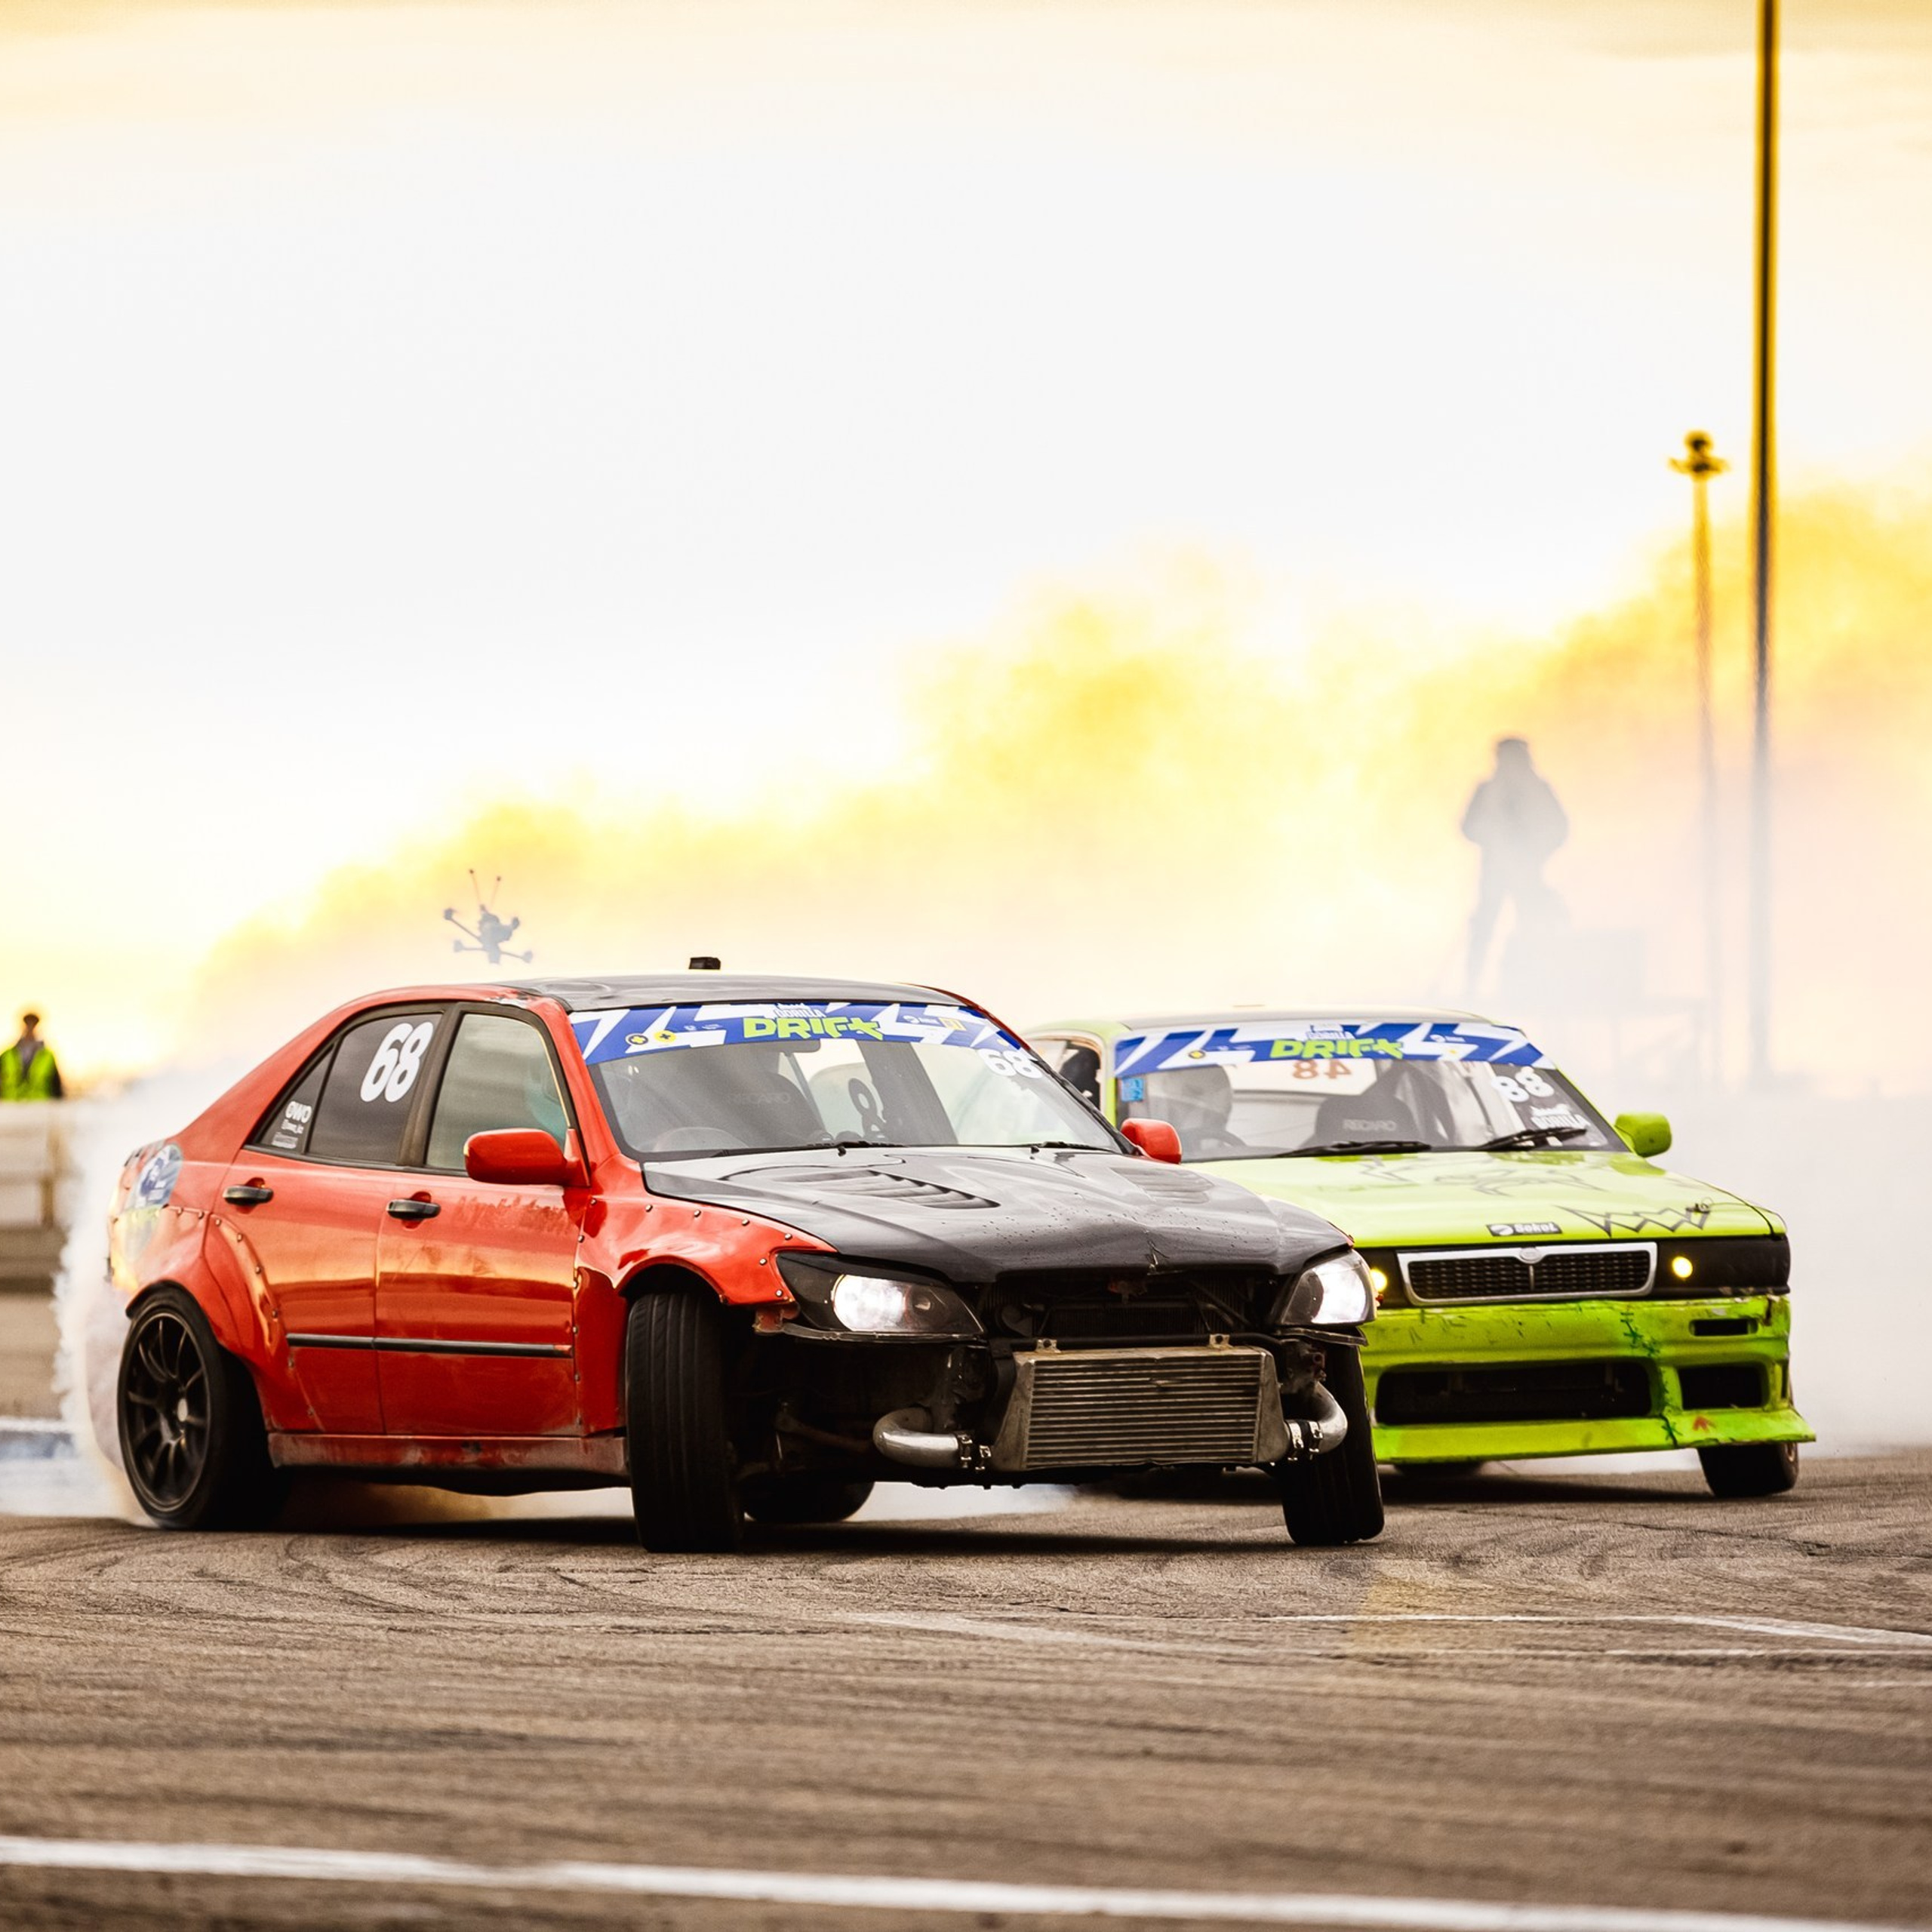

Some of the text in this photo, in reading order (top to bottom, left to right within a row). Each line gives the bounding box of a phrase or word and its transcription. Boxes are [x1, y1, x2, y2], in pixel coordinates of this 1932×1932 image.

[774, 1008, 826, 1018] GORILLA
[360, 1021, 434, 1103] 68
[978, 1048, 1042, 1078] 68
